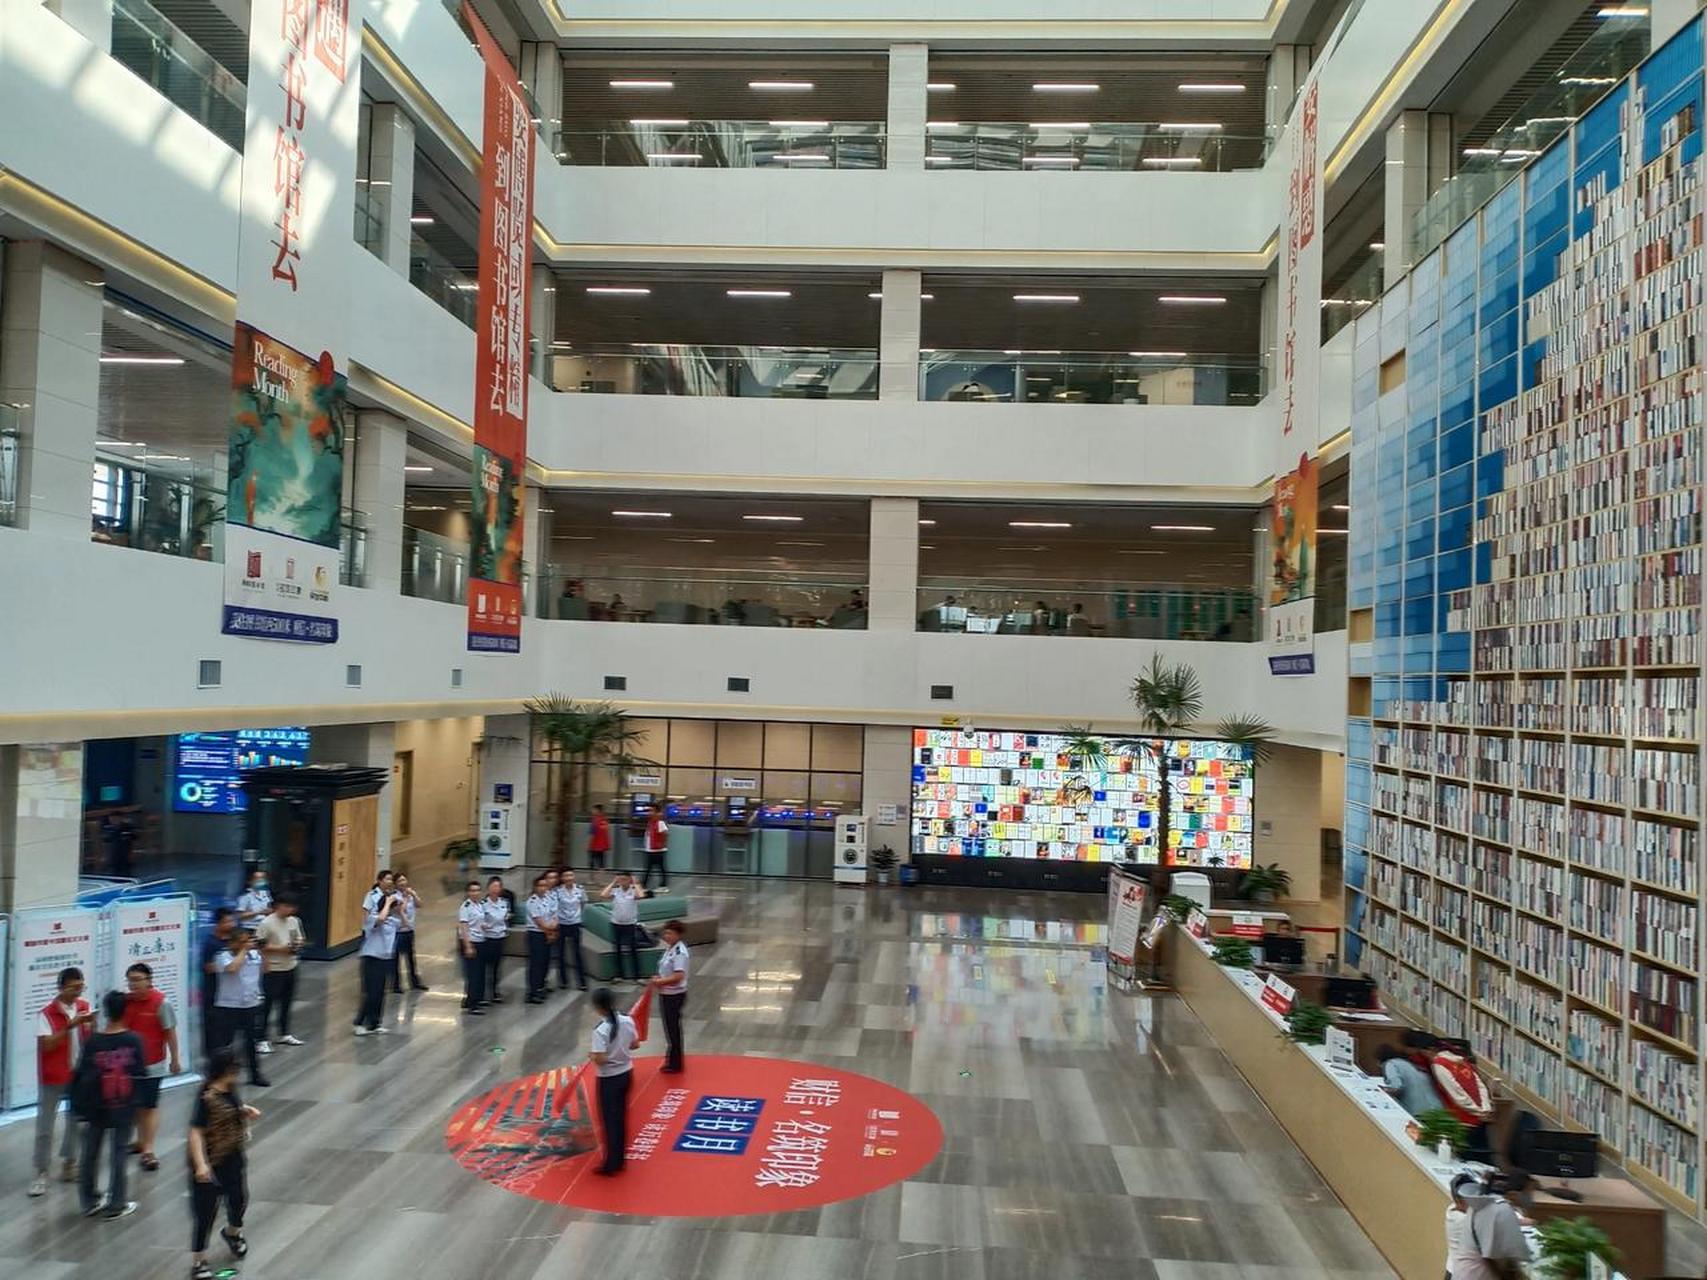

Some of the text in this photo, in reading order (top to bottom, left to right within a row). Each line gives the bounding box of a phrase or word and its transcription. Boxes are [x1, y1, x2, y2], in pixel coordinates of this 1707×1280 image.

[252, 367, 289, 403] Month
[254, 341, 297, 387] Reading
[680, 1098, 757, 1151] 读书月
